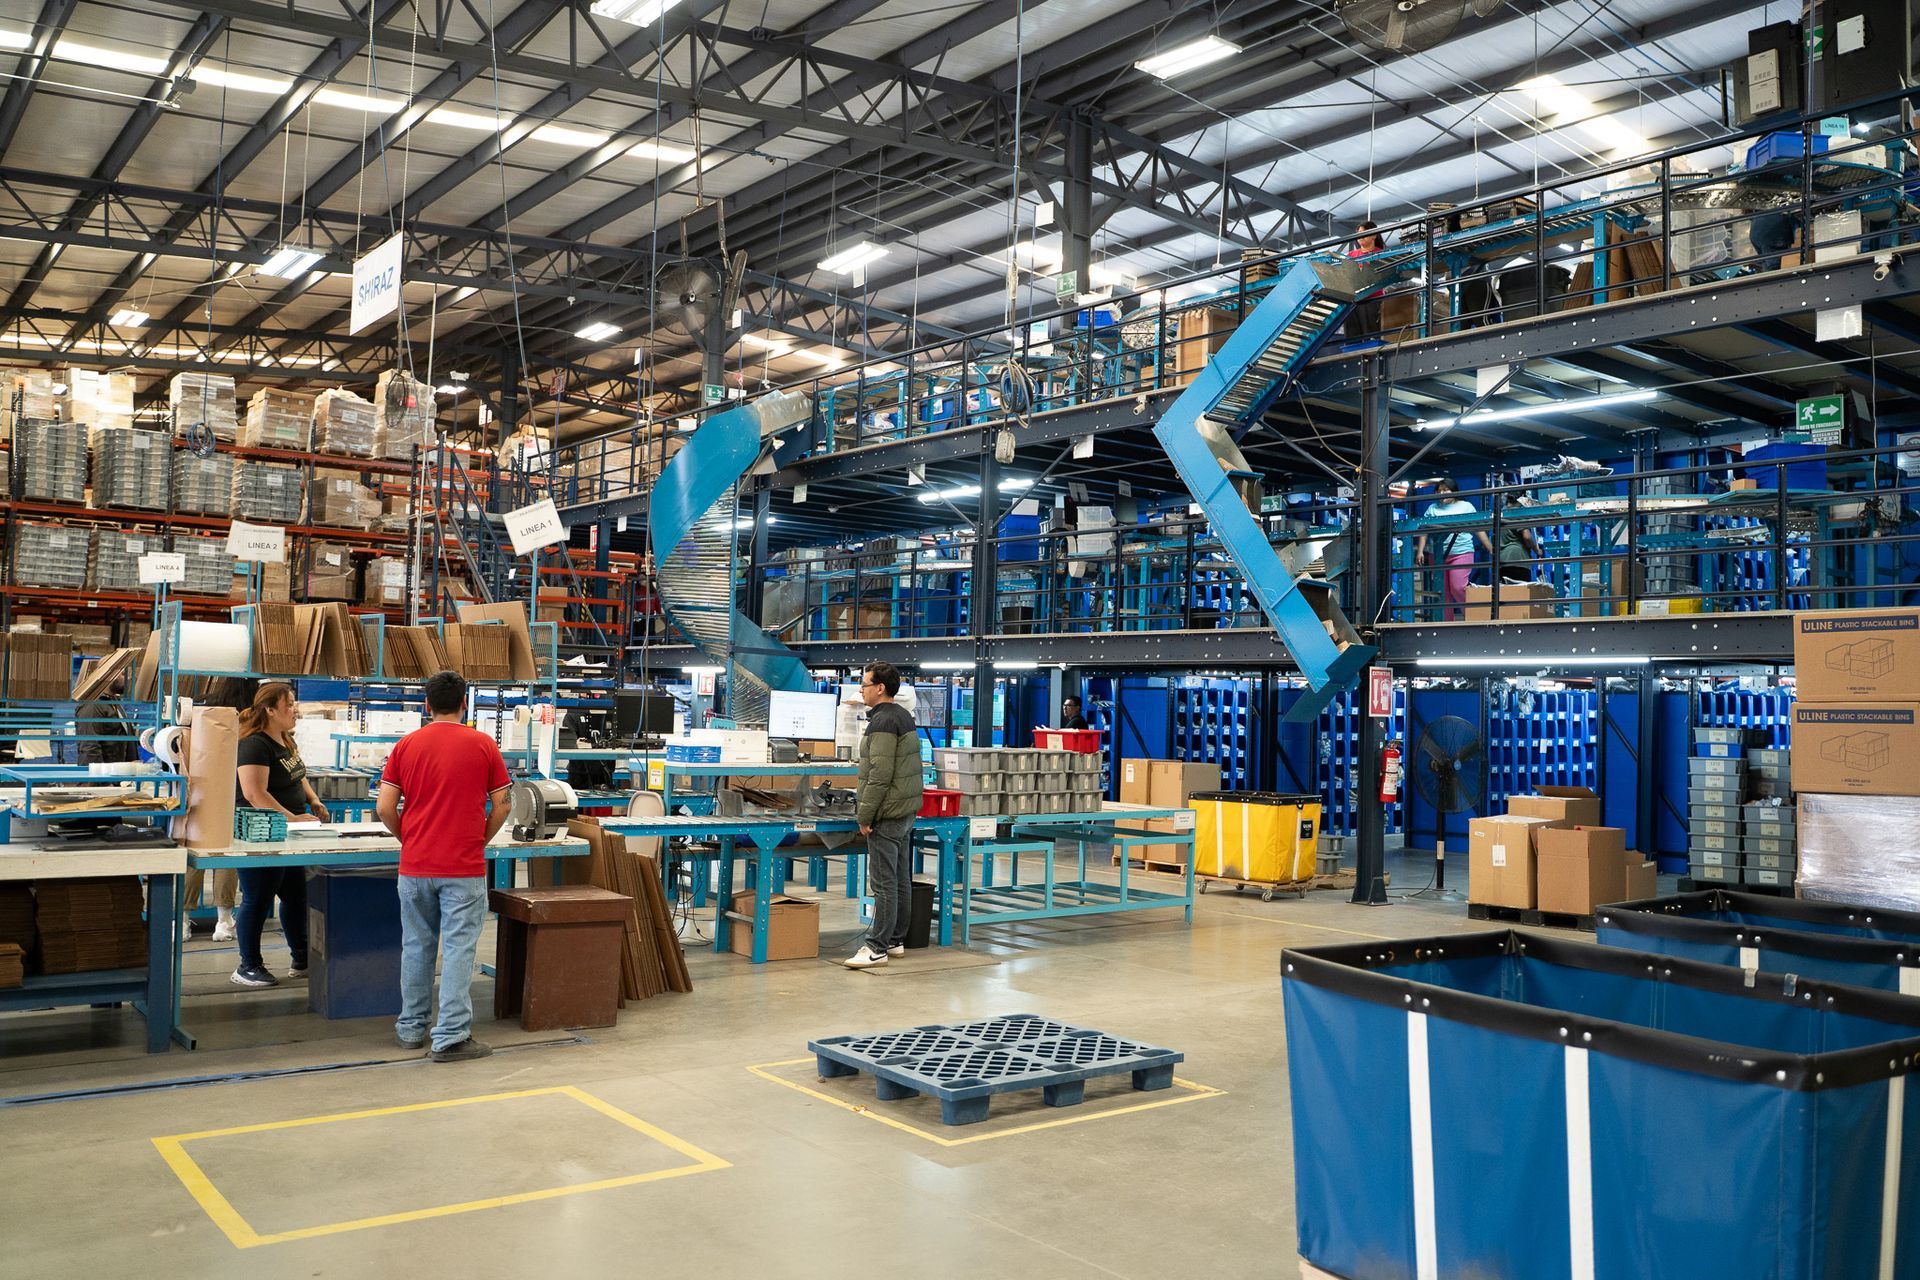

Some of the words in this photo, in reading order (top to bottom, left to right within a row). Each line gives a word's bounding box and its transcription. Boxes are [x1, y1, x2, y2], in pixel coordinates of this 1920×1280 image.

[358, 266, 394, 306] SHIRAZ
[520, 522, 546, 536] LINEA
[248, 542, 270, 550] LINEA
[1804, 622, 1832, 630] ULINE
[1800, 712, 1828, 720] ULINE
